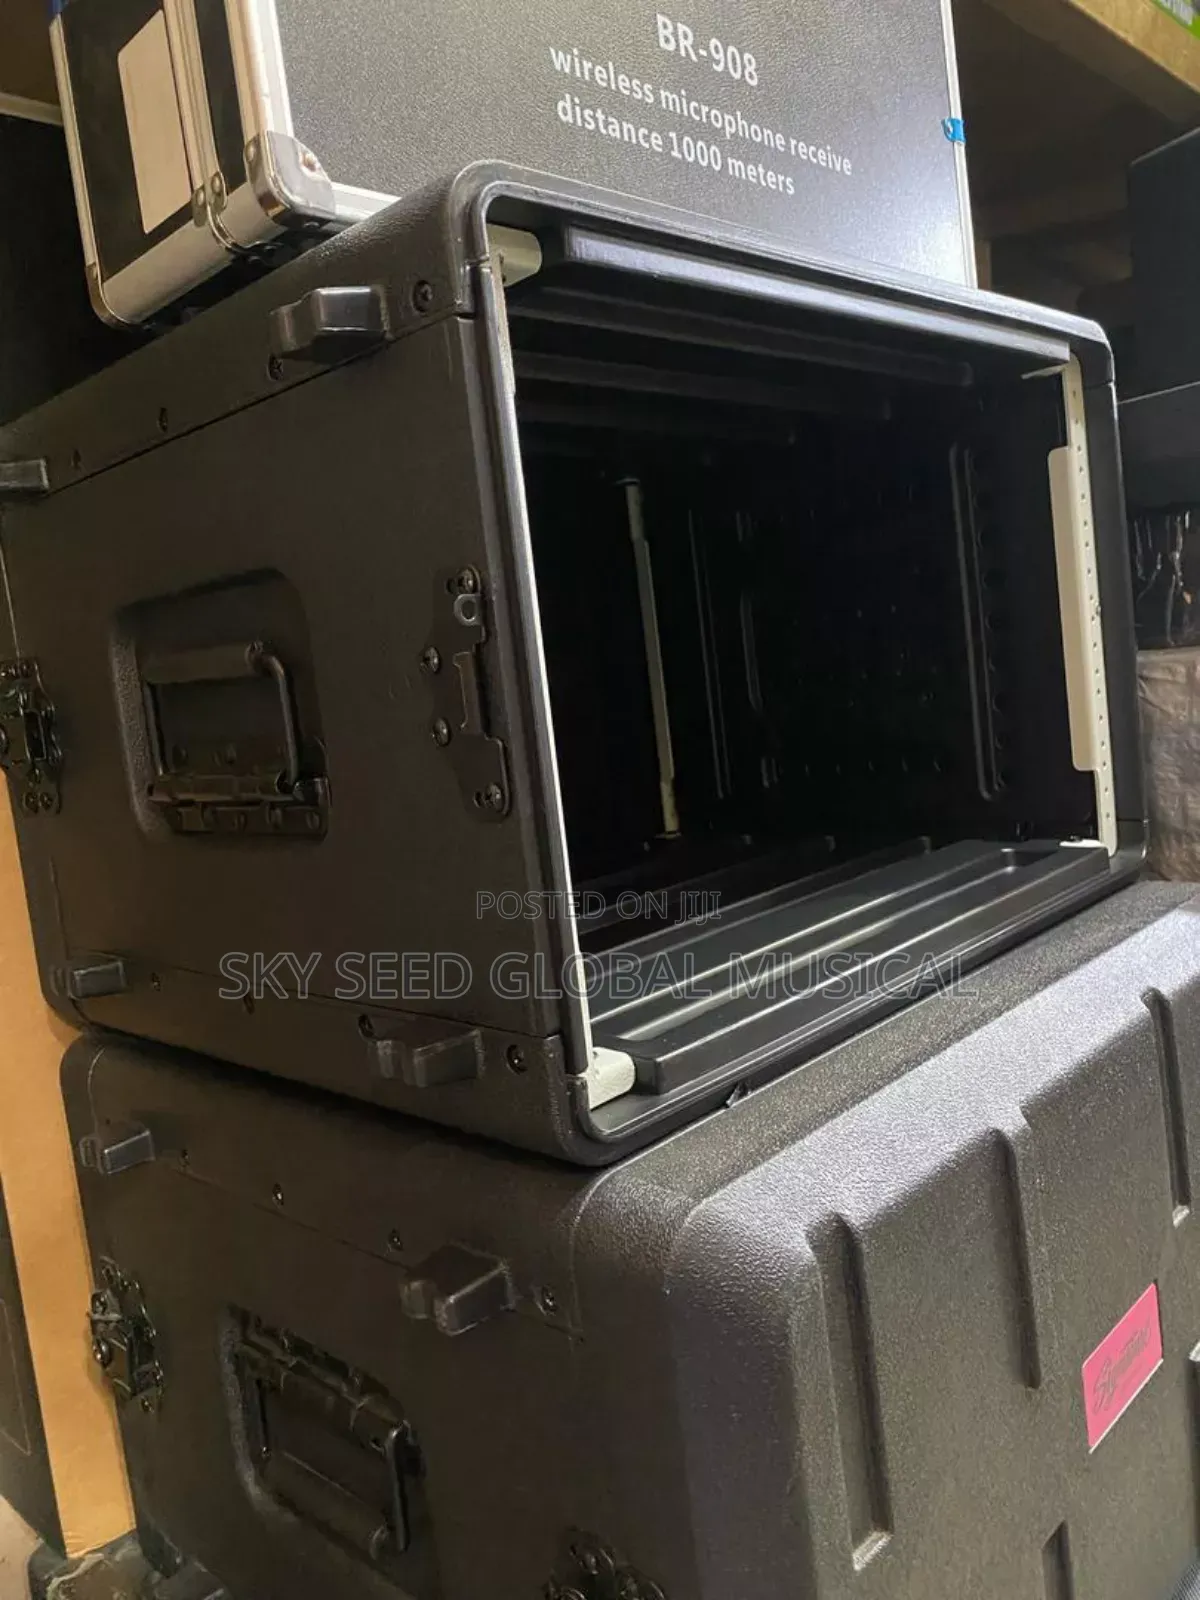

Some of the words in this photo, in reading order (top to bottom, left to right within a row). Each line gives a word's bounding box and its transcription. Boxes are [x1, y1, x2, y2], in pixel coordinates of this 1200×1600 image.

[656, 13, 758, 86] BR-908
[550, 47, 654, 103] wireless
[660, 88, 785, 151] microphone
[789, 136, 852, 176] receive
[557, 93, 663, 152] distance
[670, 131, 722, 171] 1000
[728, 156, 795, 195] meters
